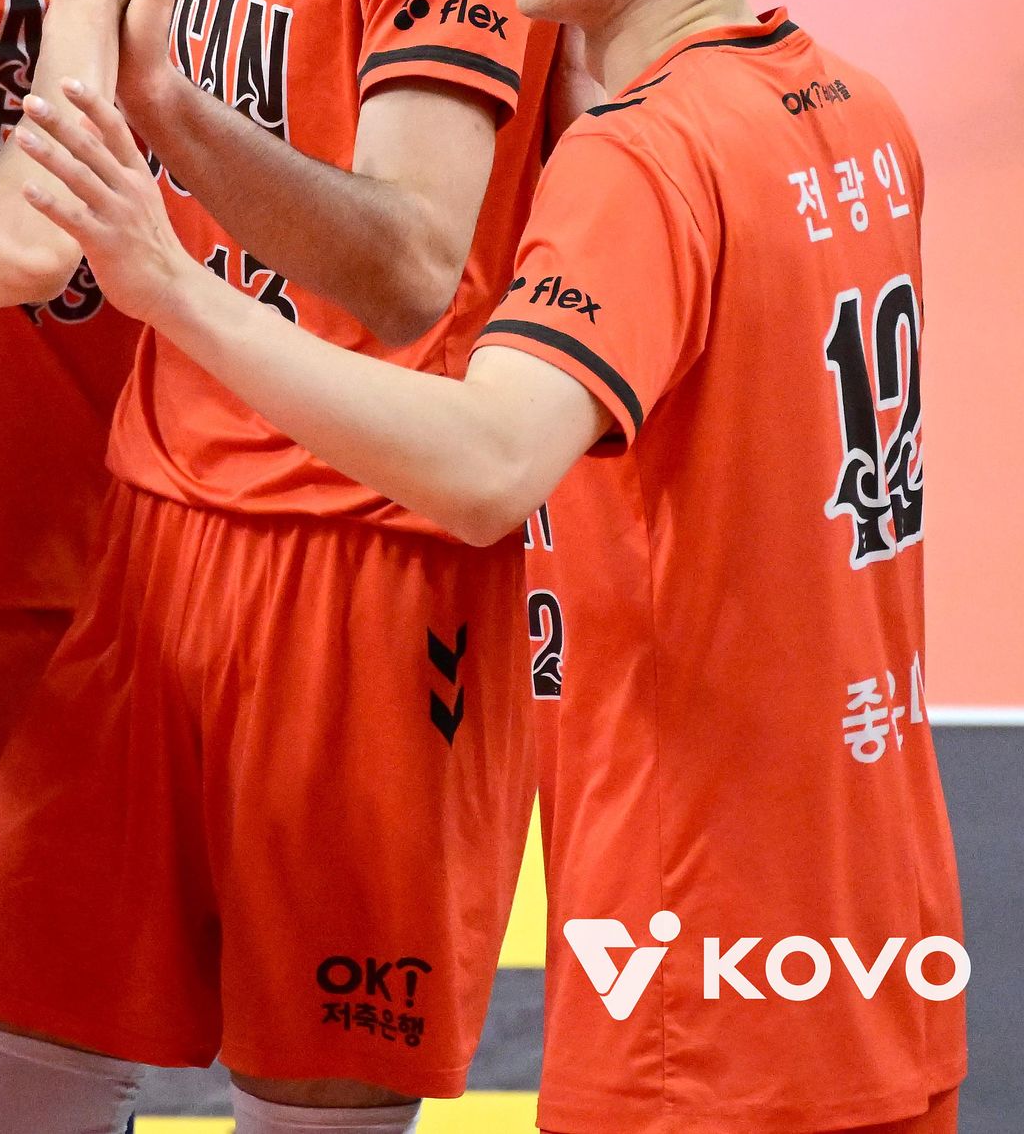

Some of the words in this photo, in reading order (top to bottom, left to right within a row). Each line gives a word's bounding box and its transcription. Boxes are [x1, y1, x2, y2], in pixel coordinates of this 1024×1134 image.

[787, 142, 911, 243] 전광인
[529, 275, 602, 325] flex
[824, 273, 925, 570] 12
[320, 1002, 425, 1047] 저축은행
